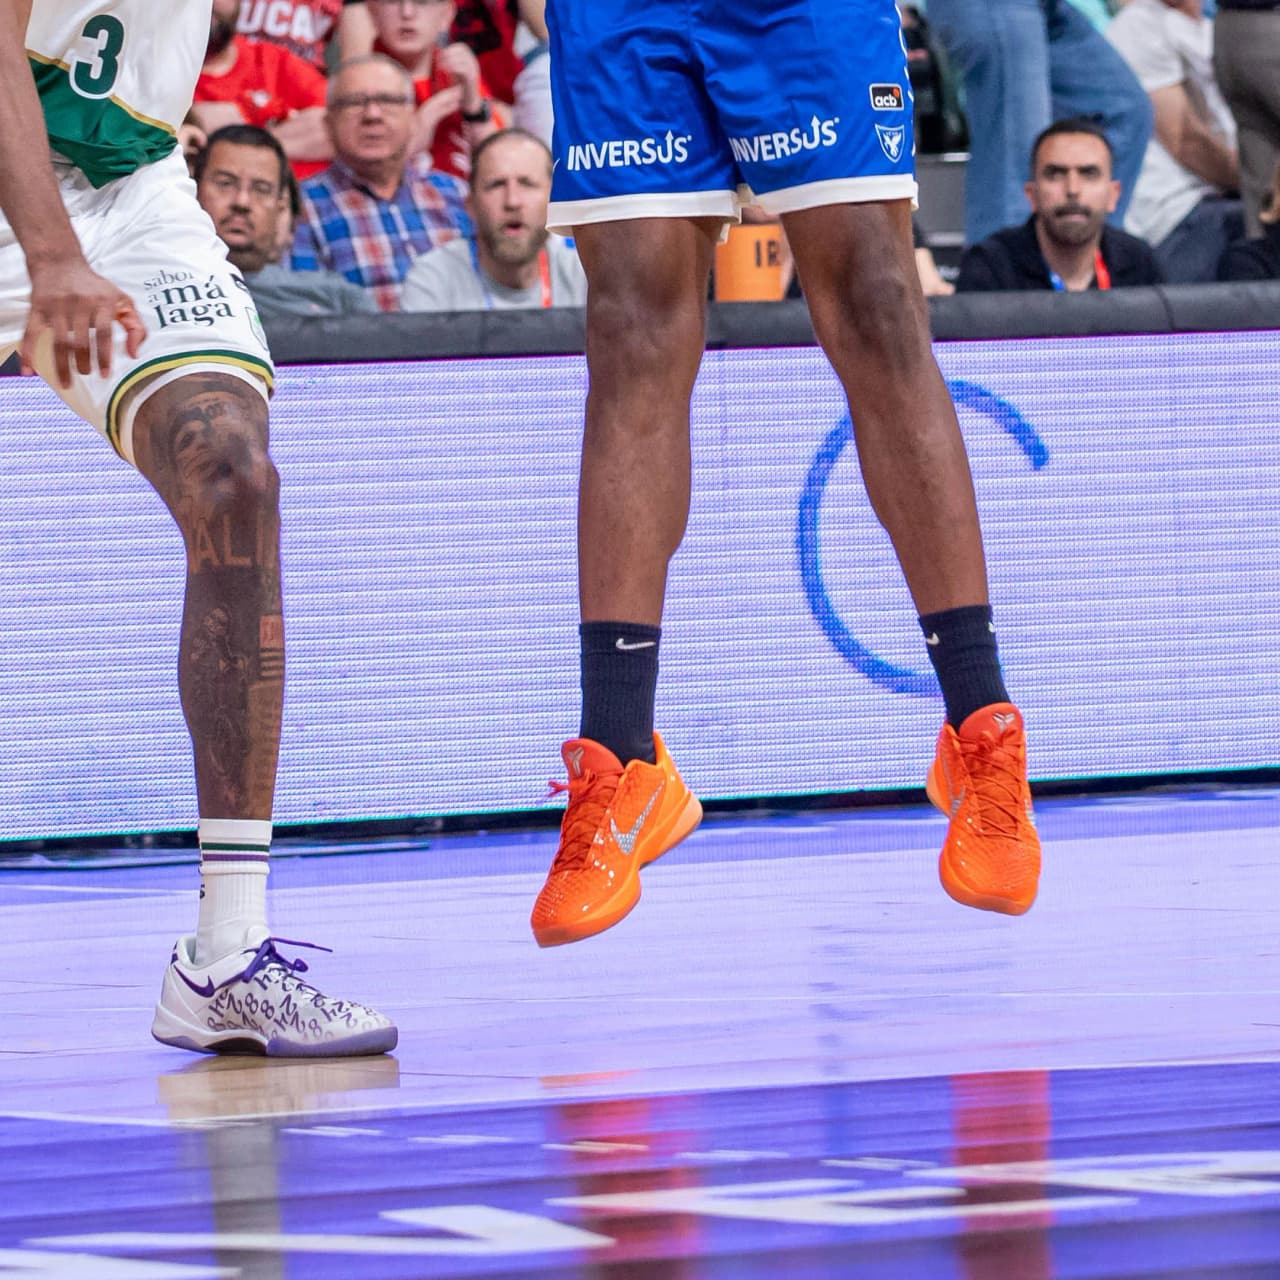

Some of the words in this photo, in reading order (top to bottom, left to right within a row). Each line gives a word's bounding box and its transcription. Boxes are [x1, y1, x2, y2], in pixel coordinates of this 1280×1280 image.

[73, 14, 126, 96] 3
[874, 93, 898, 107] acb
[567, 129, 689, 171] INVERSUS
[728, 114, 839, 163] INVERSUS
[148, 292, 160, 303] a
[161, 275, 230, 304] má
[153, 302, 237, 329] laga
